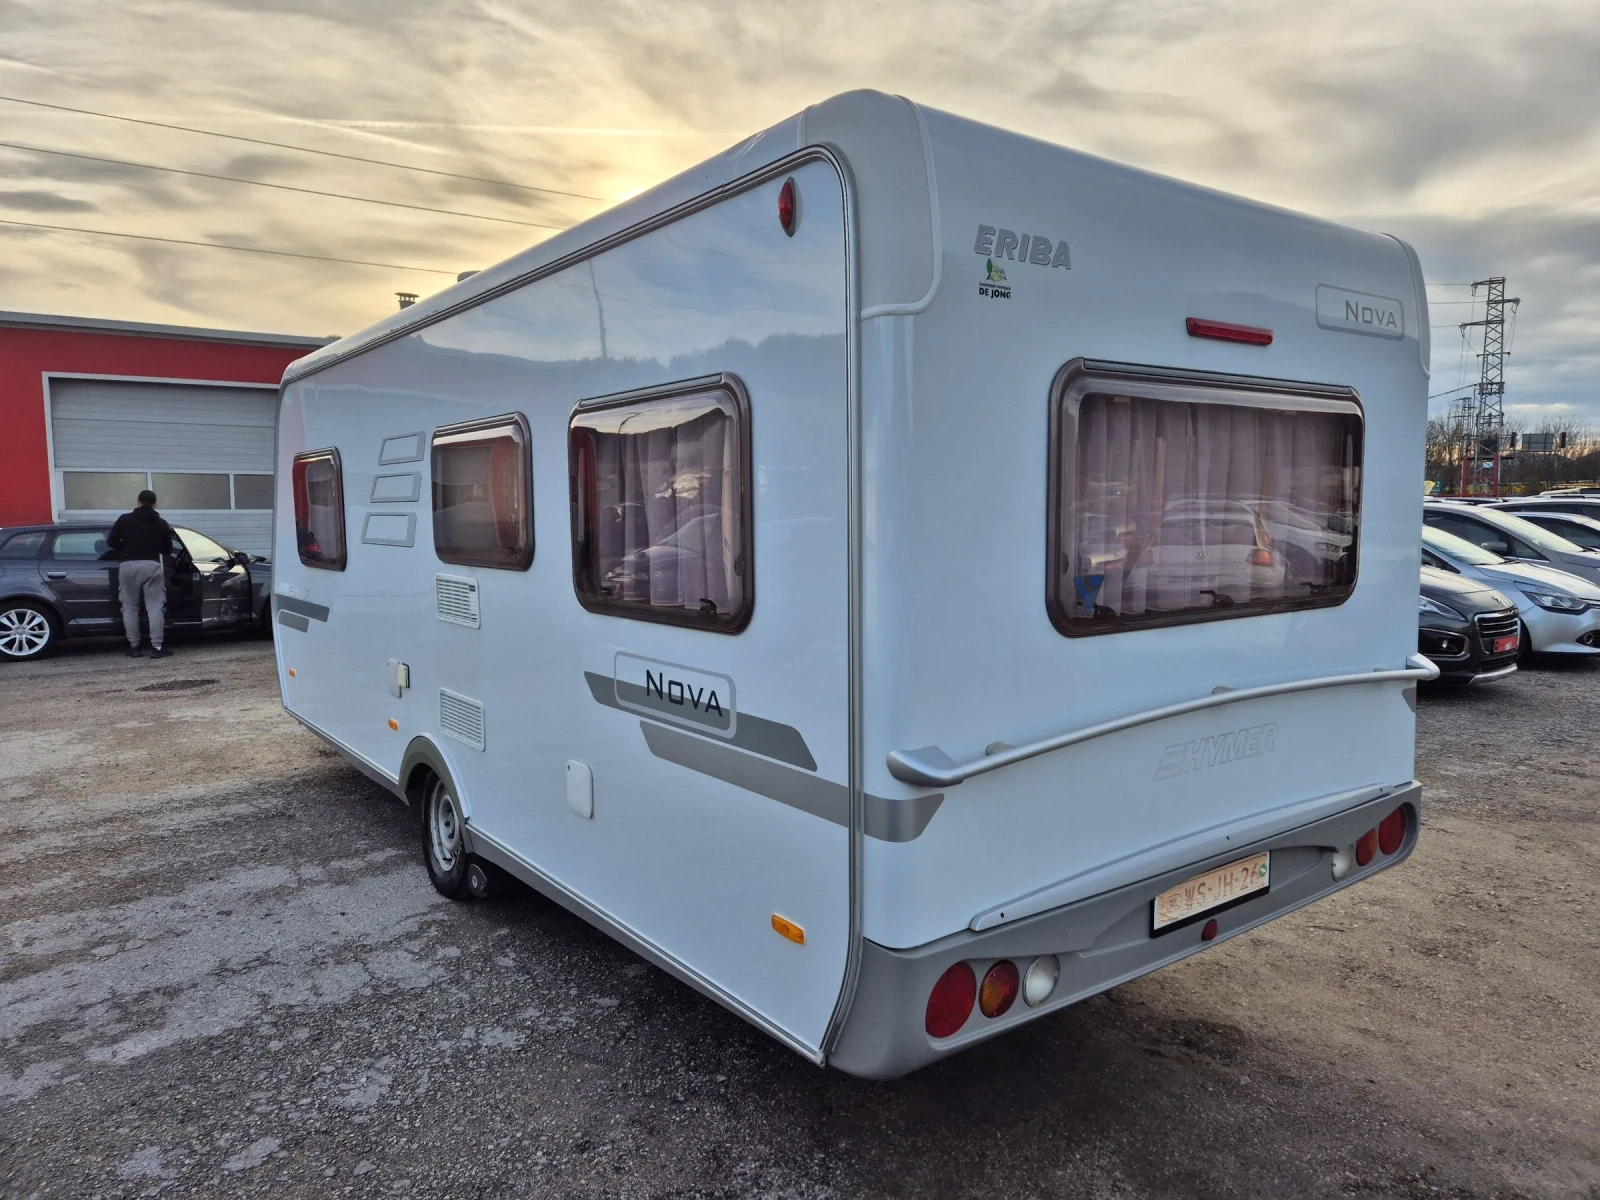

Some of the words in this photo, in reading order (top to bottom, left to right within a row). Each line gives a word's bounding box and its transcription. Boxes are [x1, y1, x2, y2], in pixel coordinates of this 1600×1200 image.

[974, 224, 1071, 270] ERIBA
[979, 287, 989, 297] DE
[991, 288, 1012, 299] JONG
[1181, 722, 1280, 773] HYMER
